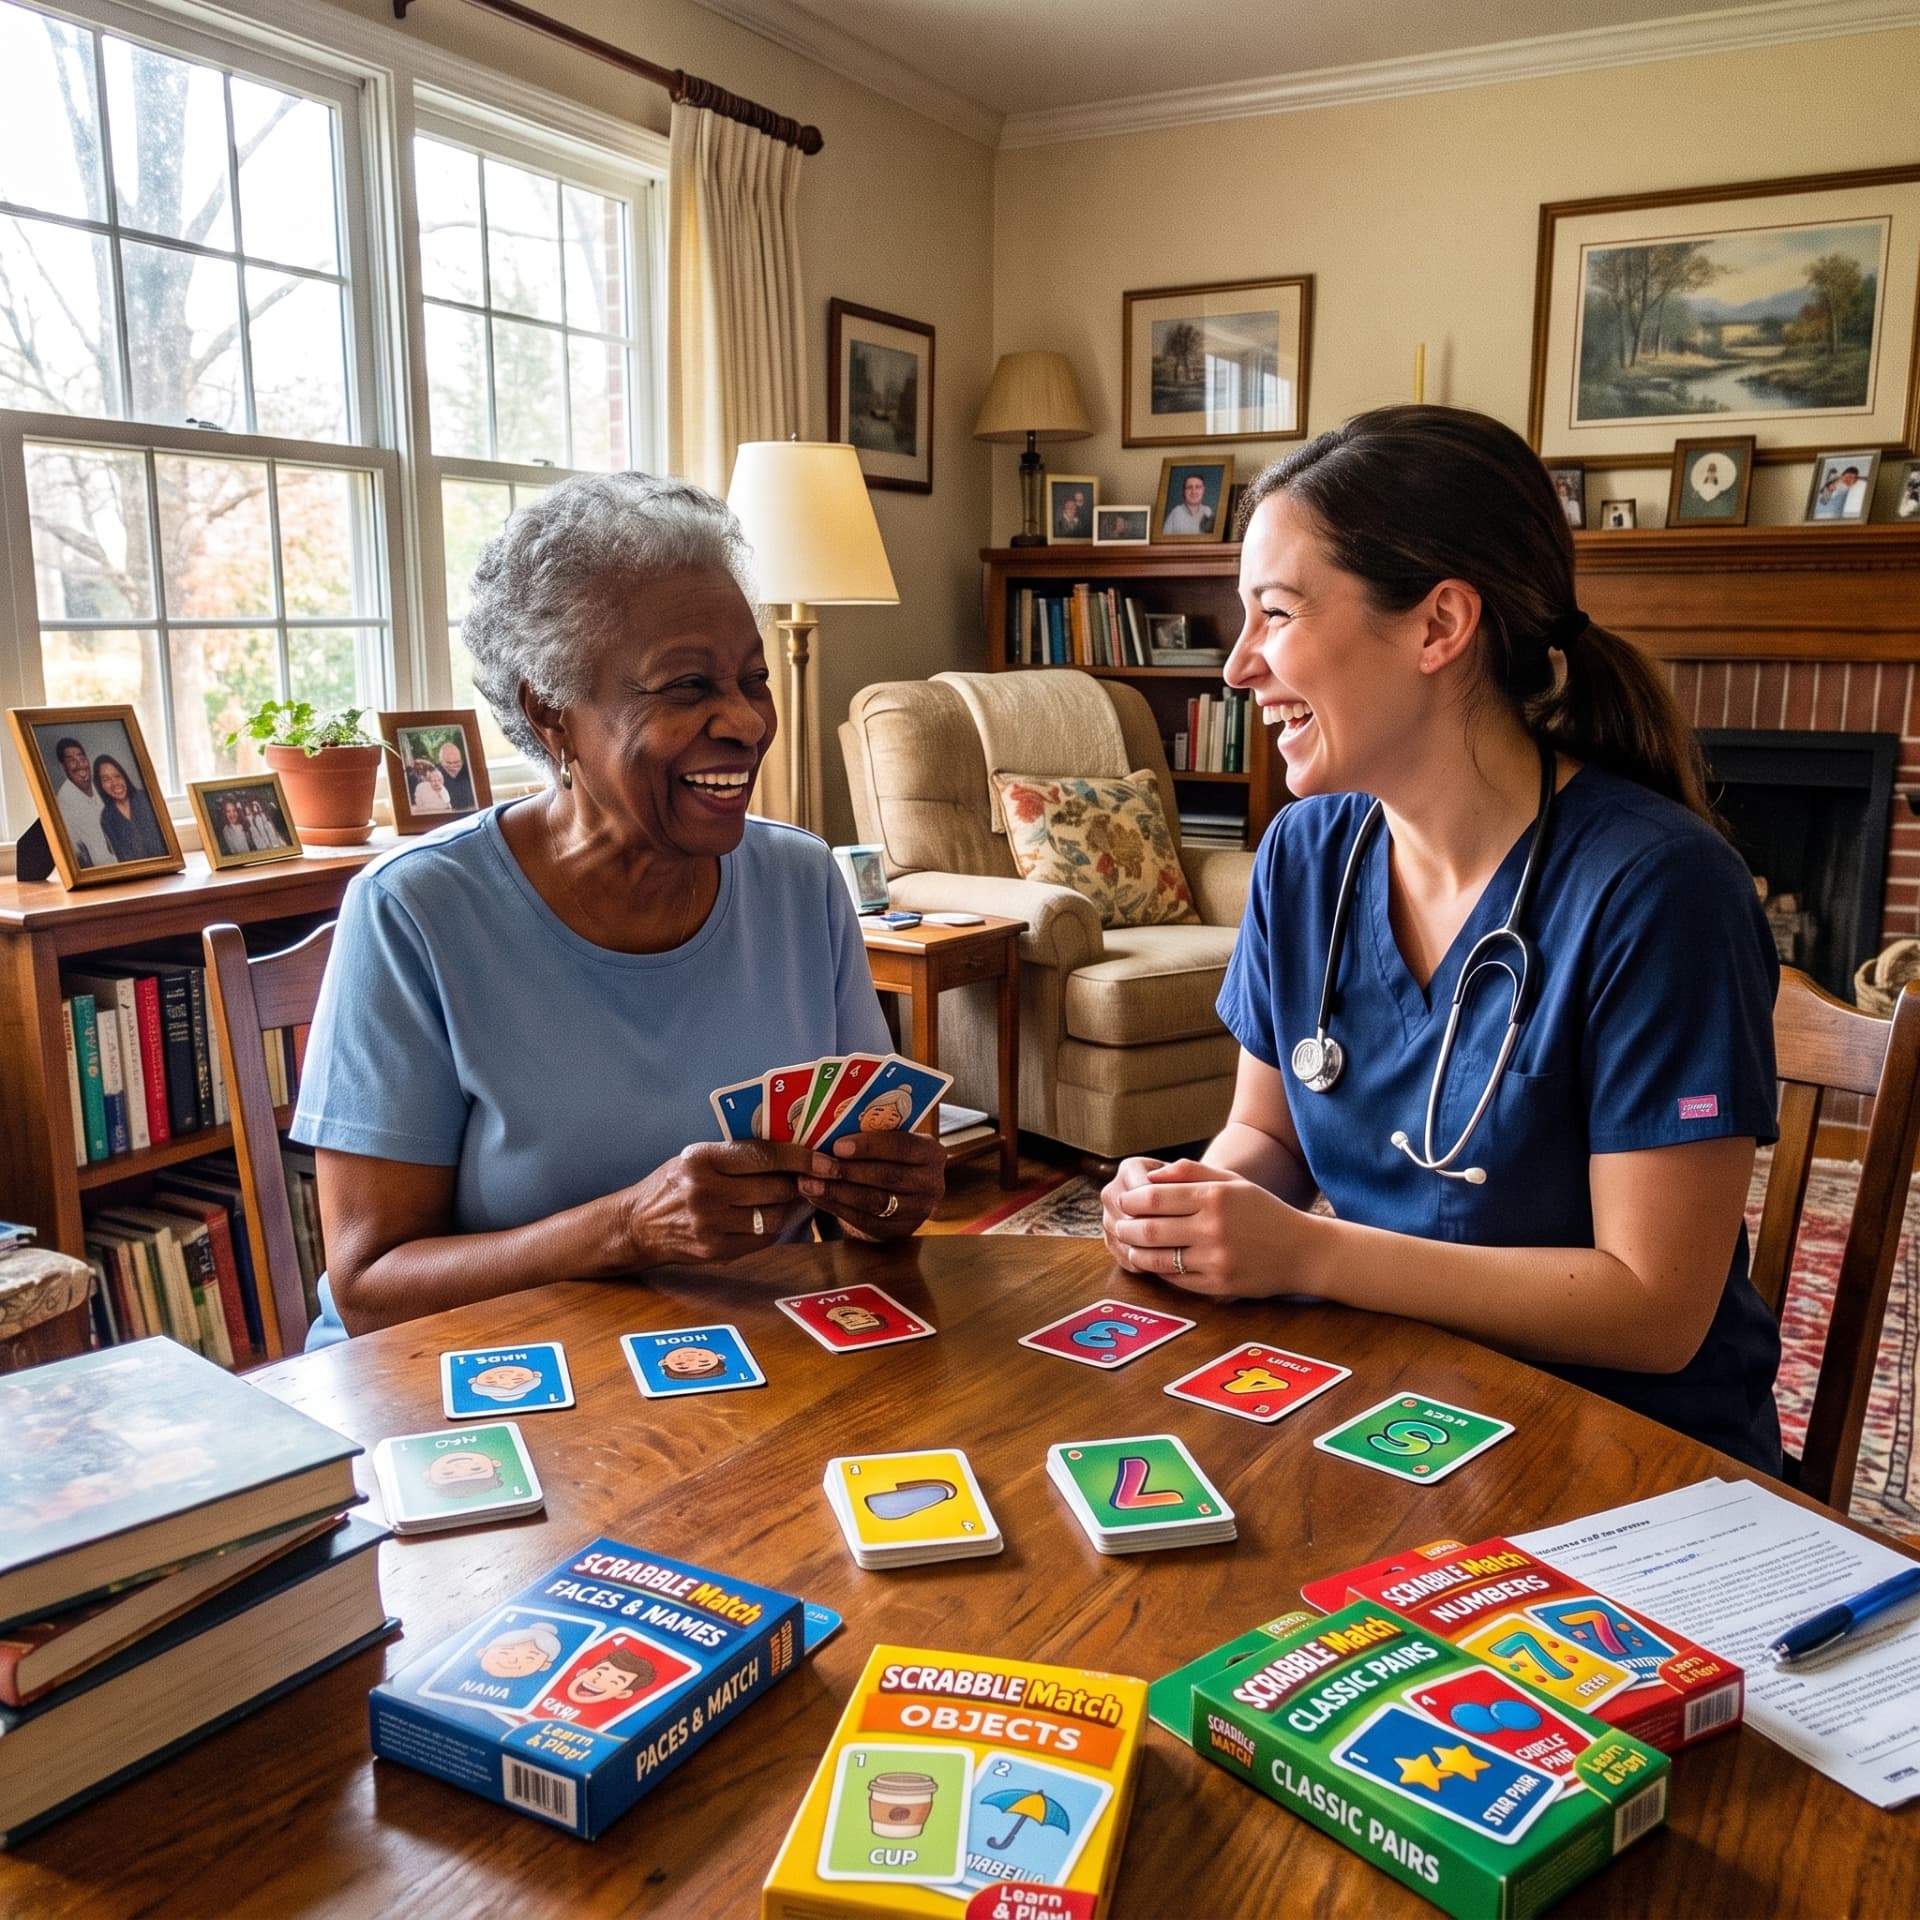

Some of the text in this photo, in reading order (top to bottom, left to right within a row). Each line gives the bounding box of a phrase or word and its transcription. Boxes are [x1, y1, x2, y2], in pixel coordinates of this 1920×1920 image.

[775, 1079, 785, 1092] 3
[824, 1067, 834, 1079] 2
[726, 1098, 735, 1110] 1
[574, 1553, 763, 1626] SCRABBLE Match
[1381, 1564, 1473, 1607] SCRABBLE
[1429, 1574, 1551, 1624] NUMBERS
[545, 1579, 728, 1647] FACES & NAMES
[1557, 1609, 1631, 1656] 7
[1232, 1641, 1339, 1710] SCRABBLE
[1318, 1616, 1401, 1655] Match
[1488, 1631, 1574, 1681] 7
[458, 1679, 510, 1699] NANA
[881, 1665, 1123, 1724] SCRABBLE Match
[1288, 1641, 1439, 1732] CLASSIC PAIRS
[635, 1657, 759, 1782] PACES & MATCH
[900, 1704, 1081, 1751] OBJECTS
[855, 1753, 865, 1767] 1
[994, 1761, 1011, 1776] 2
[1211, 1732, 1252, 1769] MATCH
[1349, 1751, 1369, 1763] 1
[1272, 1759, 1363, 1836] CLASSIC
[1369, 1817, 1439, 1884] PAIRS
[1482, 1774, 1540, 1826] STAR PAIR
[869, 1848, 918, 1867] CUP
[992, 1902, 1011, 1920] &
[1000, 1885, 1062, 1908] Learn
